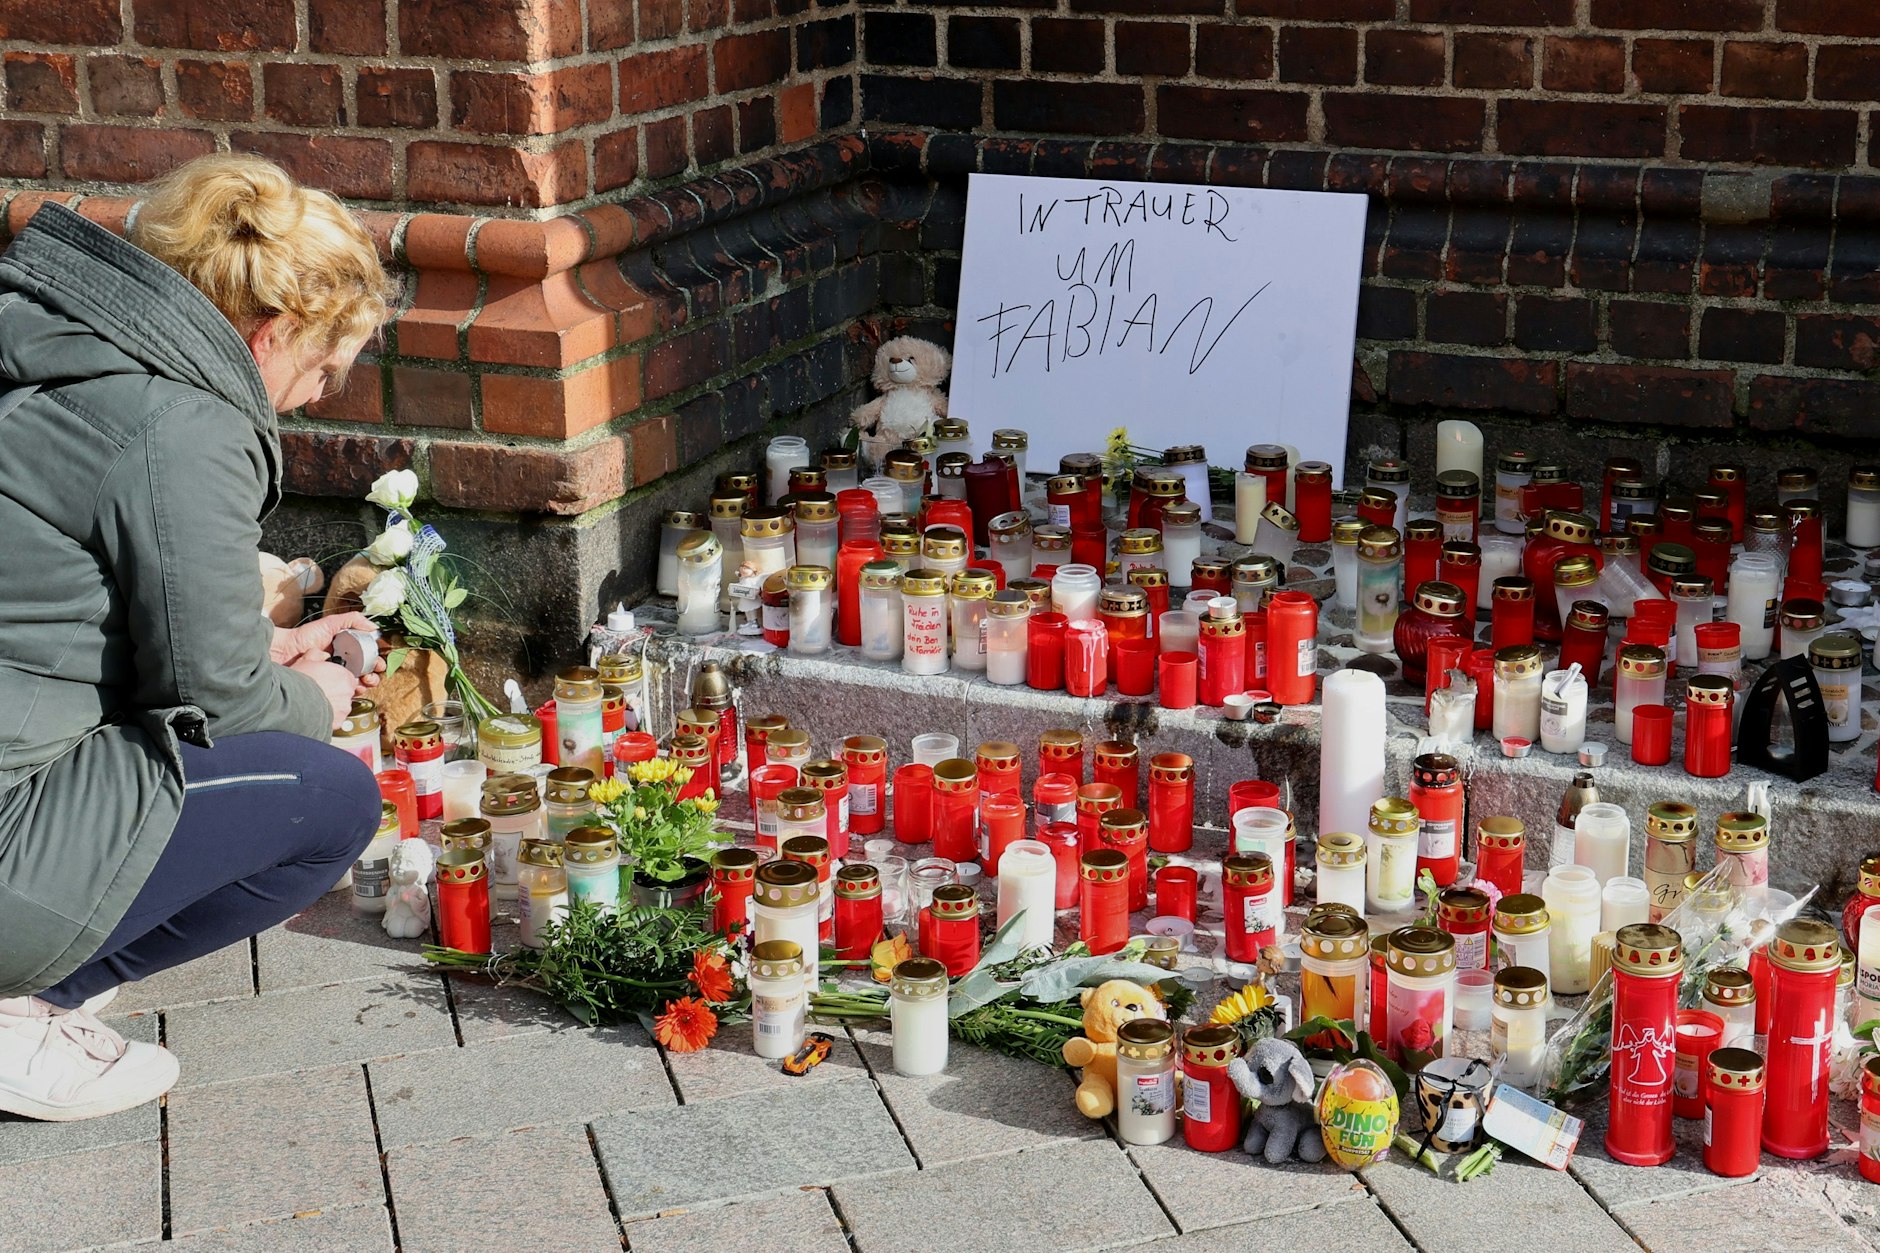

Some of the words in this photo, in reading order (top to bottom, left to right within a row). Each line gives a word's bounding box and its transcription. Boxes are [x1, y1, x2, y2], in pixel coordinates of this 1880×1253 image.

[1019, 192, 1060, 235] IN
[1064, 186, 1238, 242] TRAUER
[1056, 239, 1136, 293] UM
[977, 281, 1272, 379] FABIAN
[907, 604, 928, 617] Ruhe
[1332, 1106, 1387, 1134] DINO
[1340, 1129, 1376, 1148] FUN
